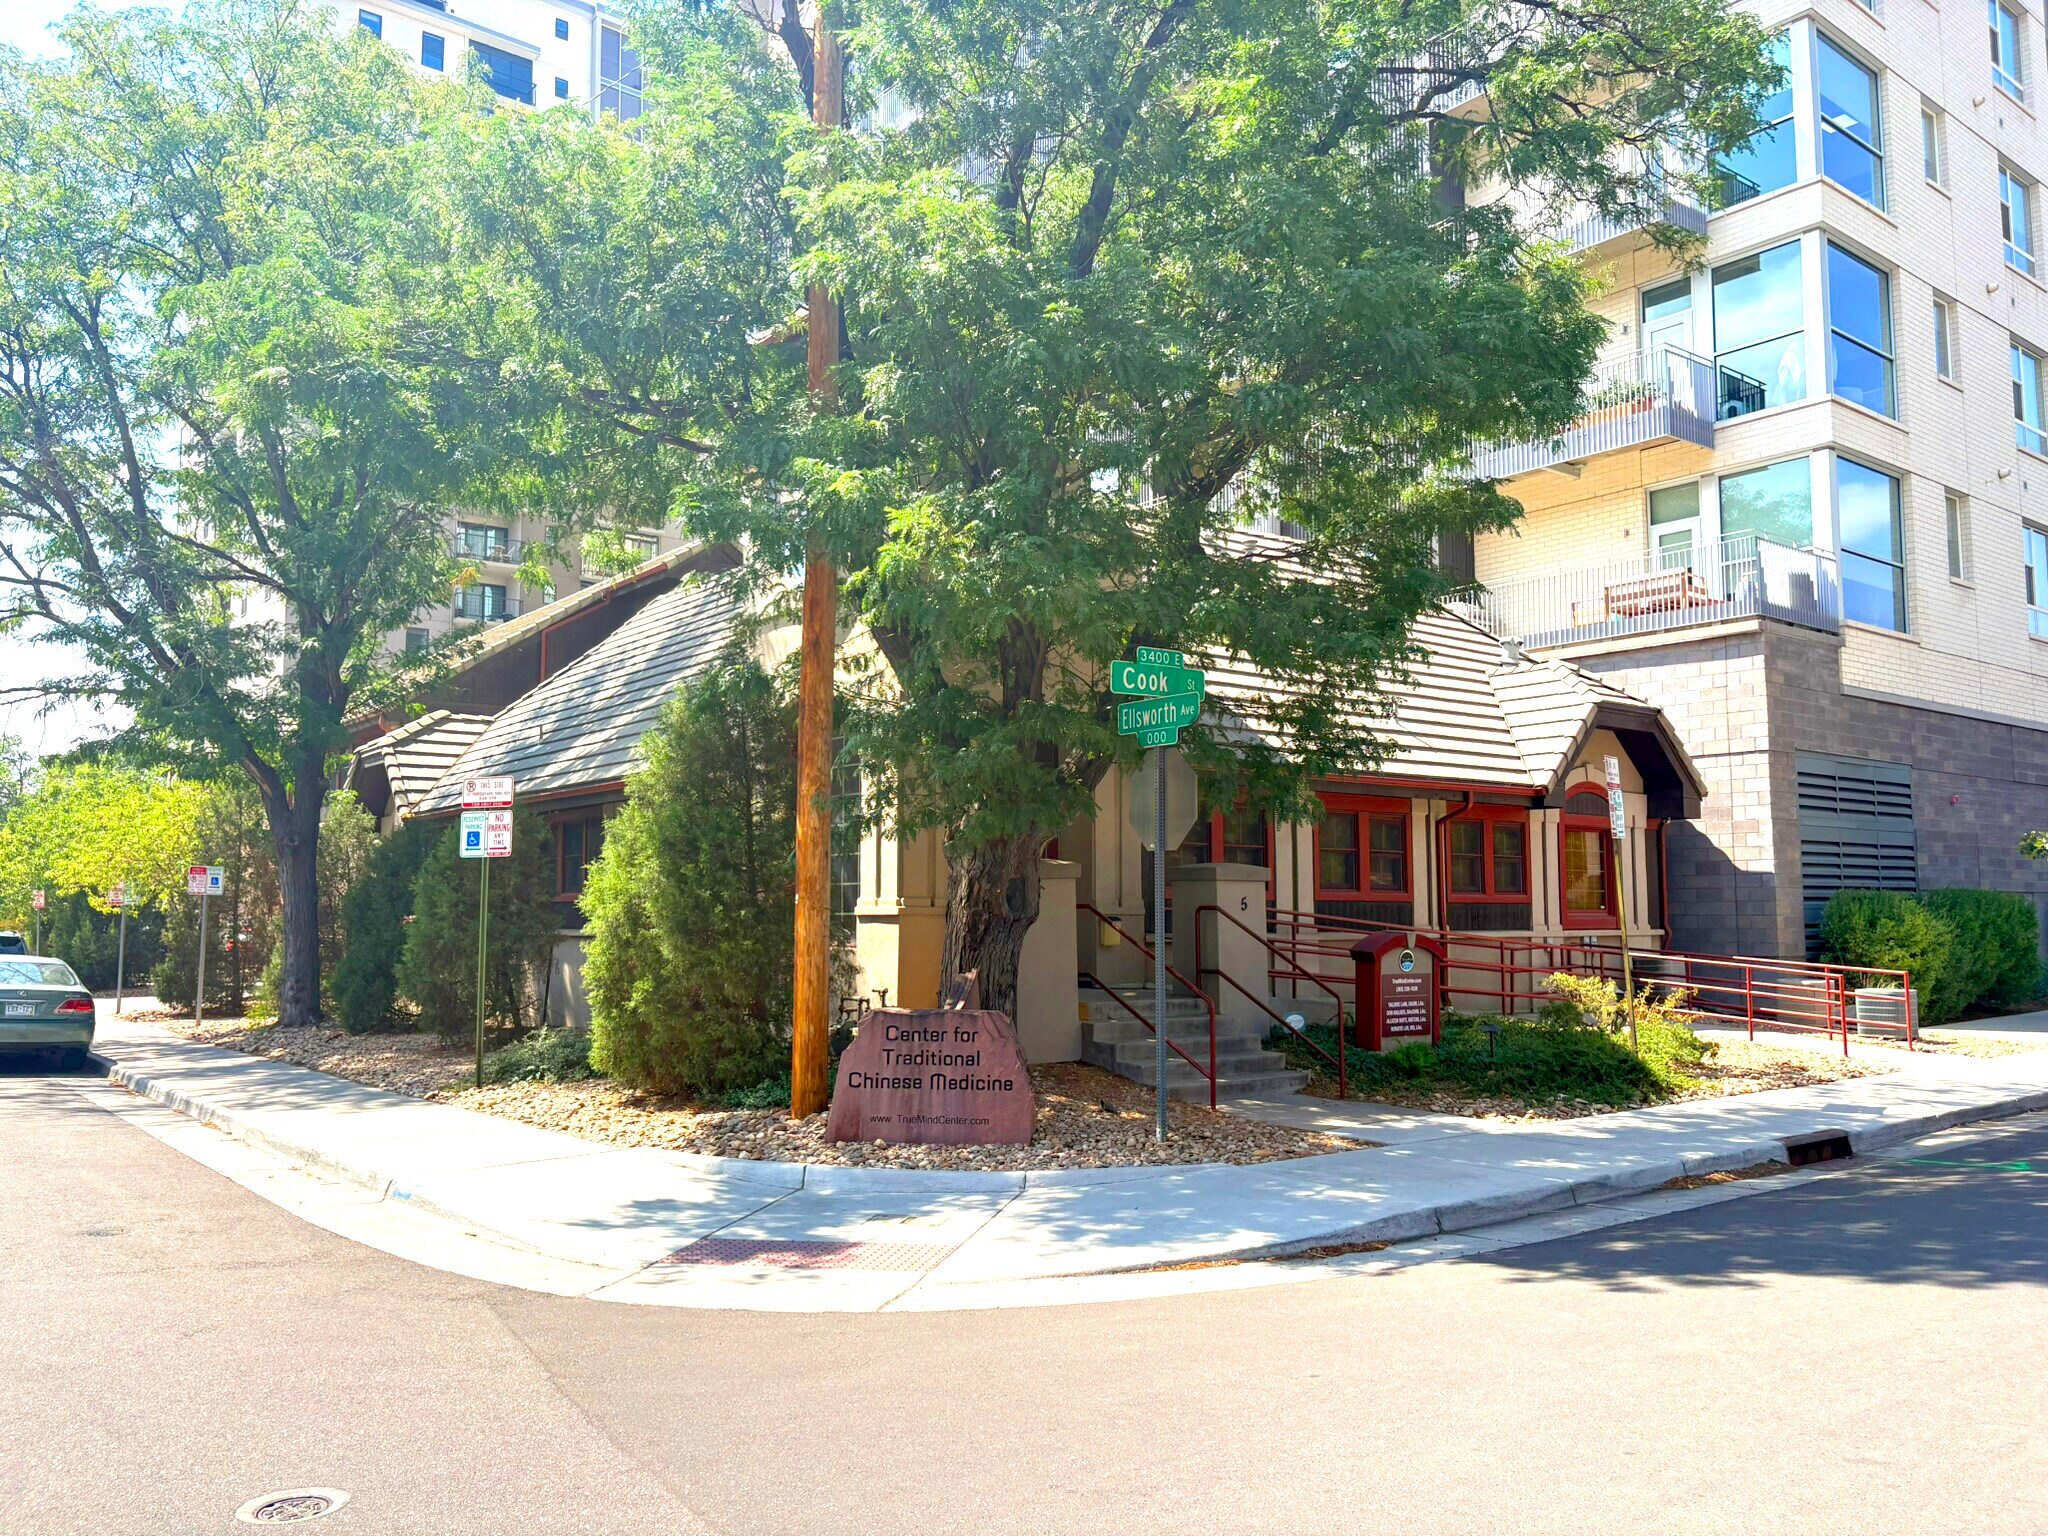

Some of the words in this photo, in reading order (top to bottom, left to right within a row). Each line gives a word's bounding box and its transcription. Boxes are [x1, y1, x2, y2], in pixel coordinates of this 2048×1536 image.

[1140, 650, 1170, 664] 3400
[1175, 654, 1181, 666] E
[1123, 667, 1168, 692] Cook
[1187, 679, 1195, 690] St
[1122, 702, 1177, 730] Ellsworth
[1180, 704, 1195, 716] Ave
[1147, 731, 1167, 744] 000
[495, 813, 504, 822] NO
[488, 823, 510, 832] PARKING
[1240, 896, 1248, 911] 5
[886, 1025, 948, 1043] Center
[954, 1026, 979, 1043] for
[882, 1049, 980, 1067] Traditional
[849, 1072, 922, 1089] Chinese
[930, 1073, 1014, 1091] Medicine
[897, 1114, 990, 1126] TrueMindCenter.com
